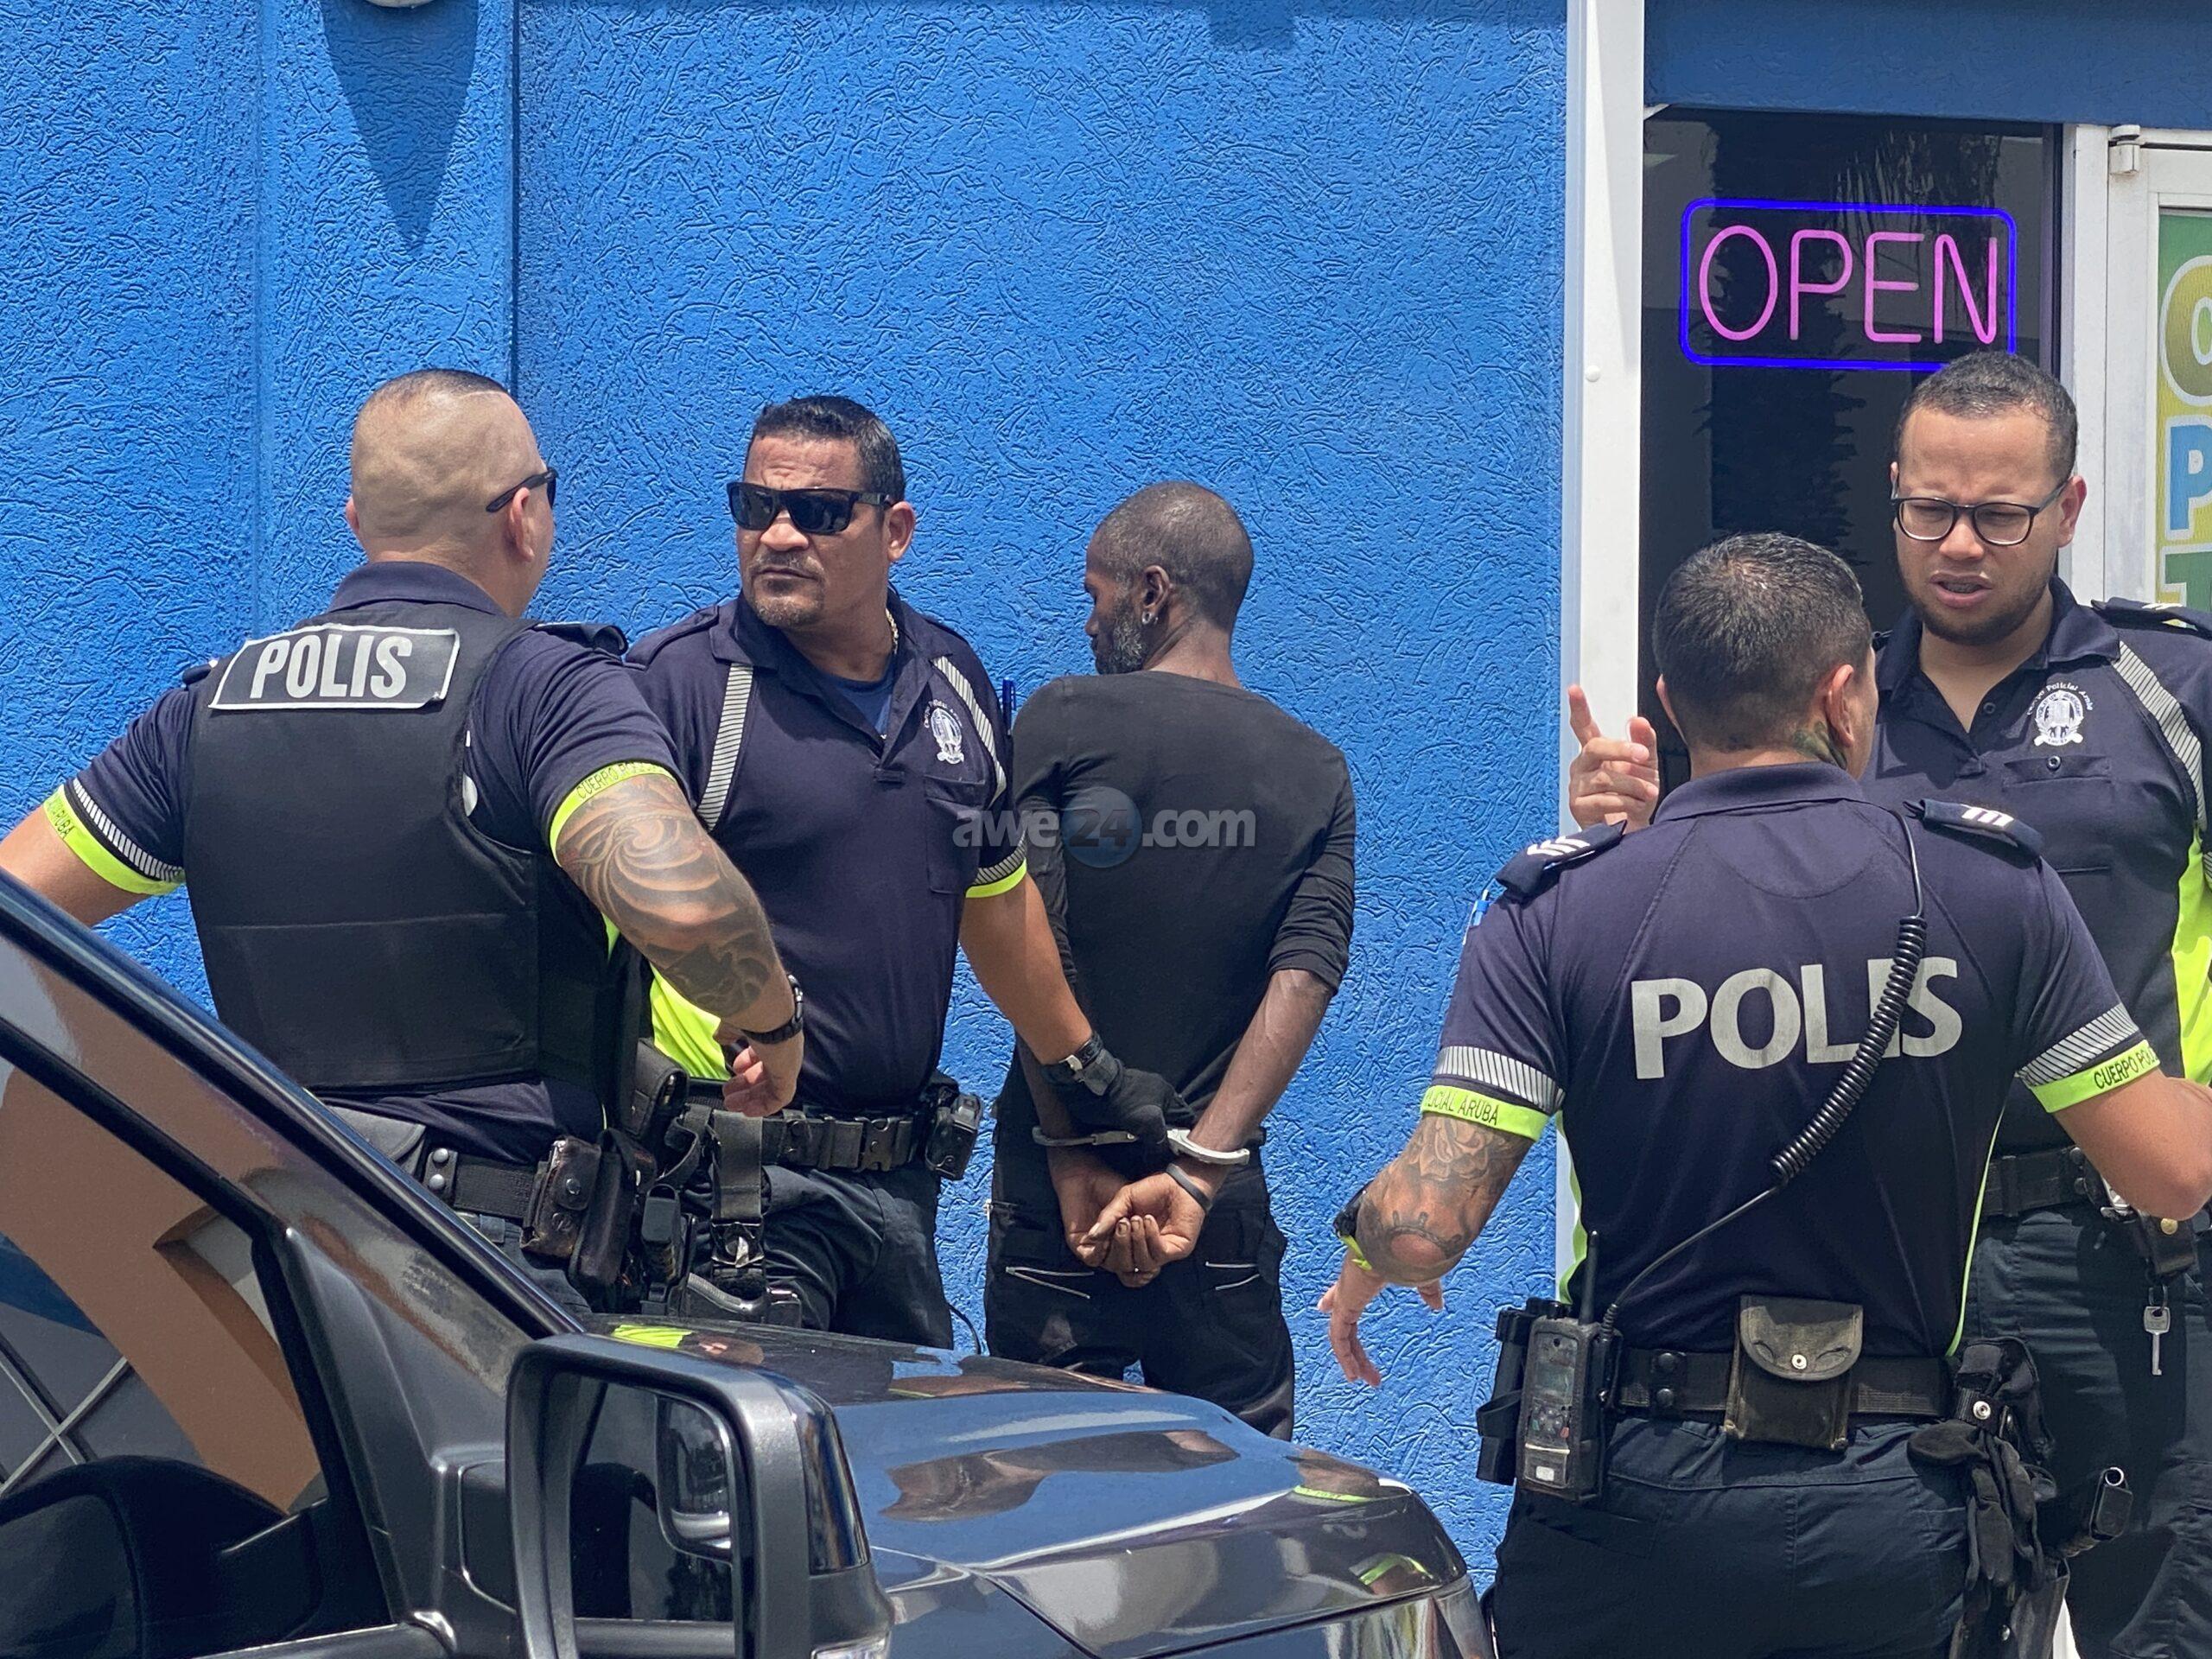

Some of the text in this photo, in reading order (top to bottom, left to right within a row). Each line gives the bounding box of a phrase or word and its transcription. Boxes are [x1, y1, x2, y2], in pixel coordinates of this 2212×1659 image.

[1699, 224, 1998, 345] OPEN
[249, 633, 413, 699] POLIS
[576, 766, 620, 799] CUERPO
[1630, 956, 1963, 1080] POLIS
[2094, 1056, 2139, 1090] CUERPO
[1458, 1095, 1500, 1126] ARUBA
